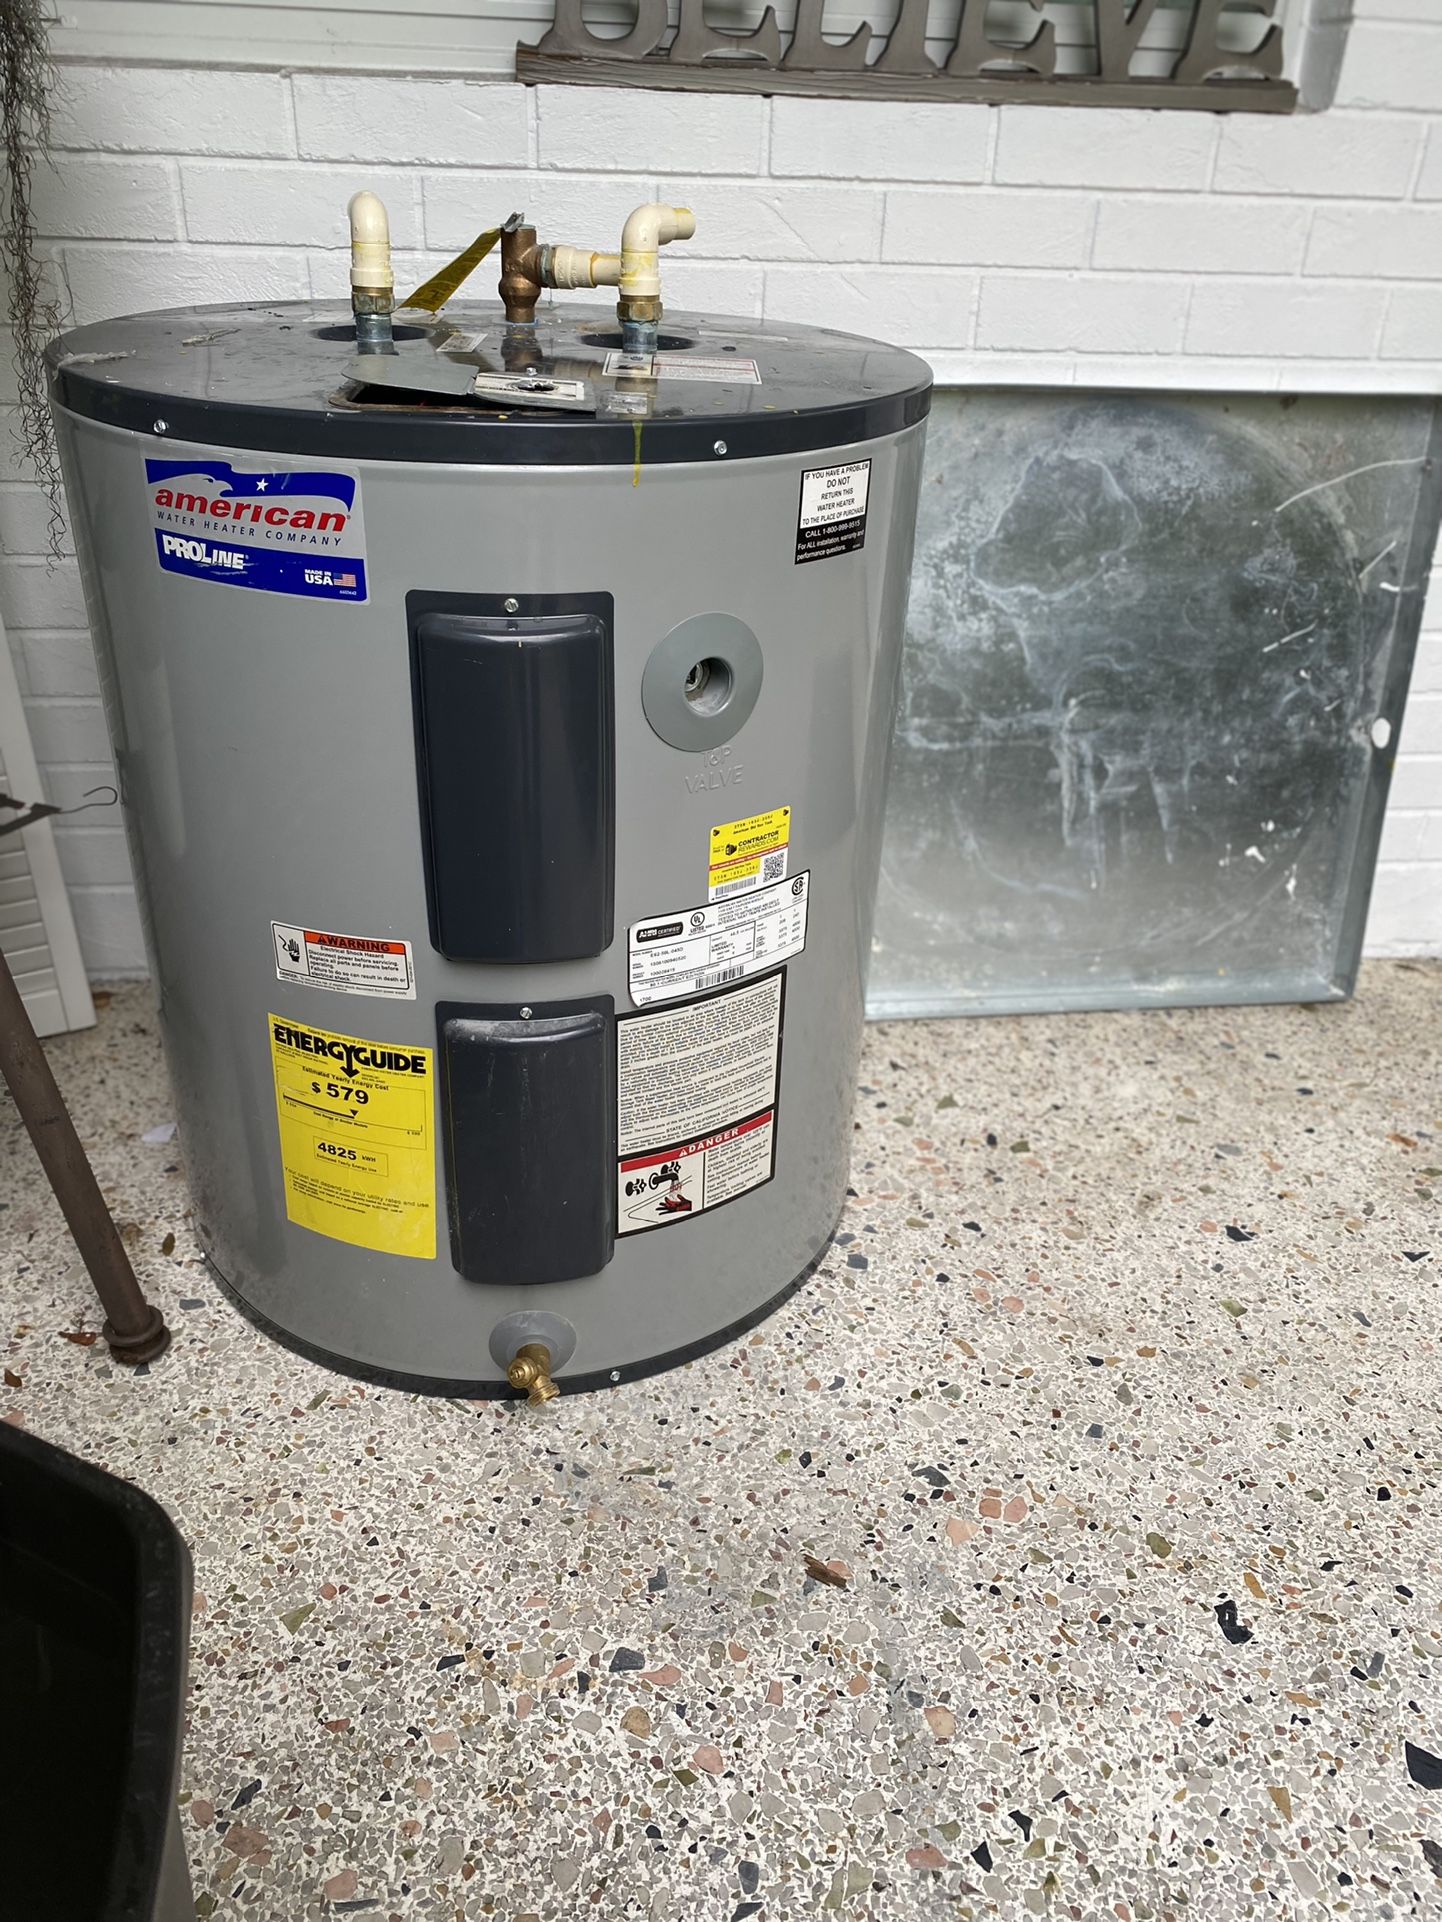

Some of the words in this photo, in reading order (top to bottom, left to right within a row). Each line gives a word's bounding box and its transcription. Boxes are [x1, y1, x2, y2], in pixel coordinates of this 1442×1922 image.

[826, 469, 840, 477] HAVE
[846, 463, 869, 473] PROBLEM
[827, 479, 837, 488] DO
[838, 476, 850, 486] NOT
[821, 490, 842, 499] RETURN
[155, 489, 346, 531] american
[817, 502, 835, 511] WATER
[836, 498, 855, 508] HEATER
[821, 513, 835, 521] PLACE
[843, 506, 864, 517] PURCHASE
[157, 511, 195, 526] WATER
[204, 521, 254, 537] HEATER
[266, 530, 342, 546] COMPANY
[805, 529, 821, 538] CALL
[305, 575, 333, 586] USA
[685, 764, 743, 793] VALVE
[738, 830, 779, 847] CONTRACTOR
[320, 945, 345, 953] Electrical
[328, 937, 390, 952] WARNING
[693, 999, 721, 1011] IMPORTANT
[274, 1023, 426, 1076] ENERGYGUIDE
[302, 1066, 330, 1079] Estimated
[331, 1074, 350, 1085] Yearly
[352, 1079, 373, 1090] Energy
[375, 1083, 389, 1091] Cost
[311, 1082, 321, 1094] $
[326, 1083, 369, 1105] 579
[666, 1123, 681, 1133] STATE
[692, 1112, 720, 1125] CALIFORNIA
[722, 1105, 738, 1114] NOTICE
[689, 1128, 739, 1154] DANGER
[317, 1142, 357, 1161] 4825
[285, 1166, 296, 1174] Your
[298, 1172, 309, 1180] cost
[320, 1181, 342, 1191] depend
[352, 1190, 366, 1198] your
[367, 1194, 383, 1202] utility
